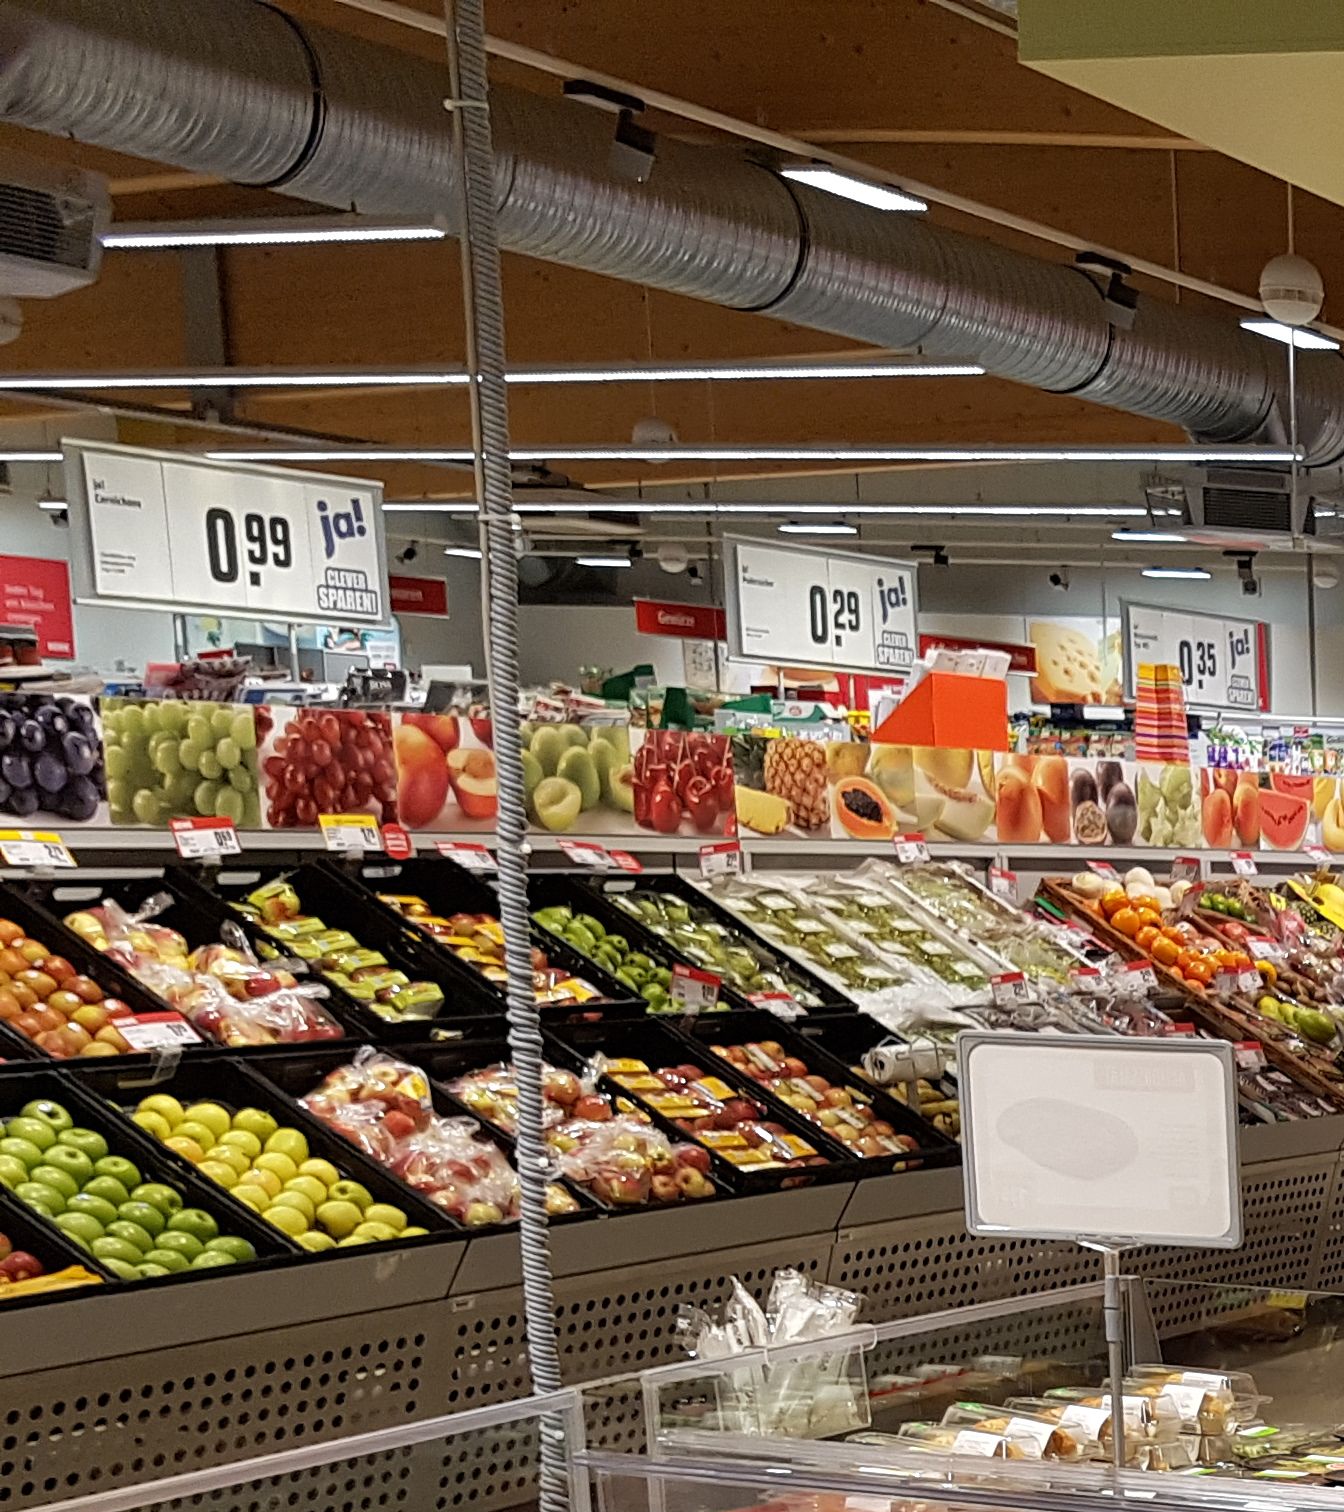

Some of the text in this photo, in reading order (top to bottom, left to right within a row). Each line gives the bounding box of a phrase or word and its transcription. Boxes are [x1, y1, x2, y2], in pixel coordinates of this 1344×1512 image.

[206, 507, 292, 587] 0.99
[317, 499, 367, 559] ja!
[318, 587, 377, 613] SPAREN!
[326, 569, 366, 589] CLEVER
[877, 576, 907, 625] ja!
[809, 585, 860, 647] 0.29
[1179, 640, 1216, 689] 0.35
[1229, 629, 1250, 668] ja!
